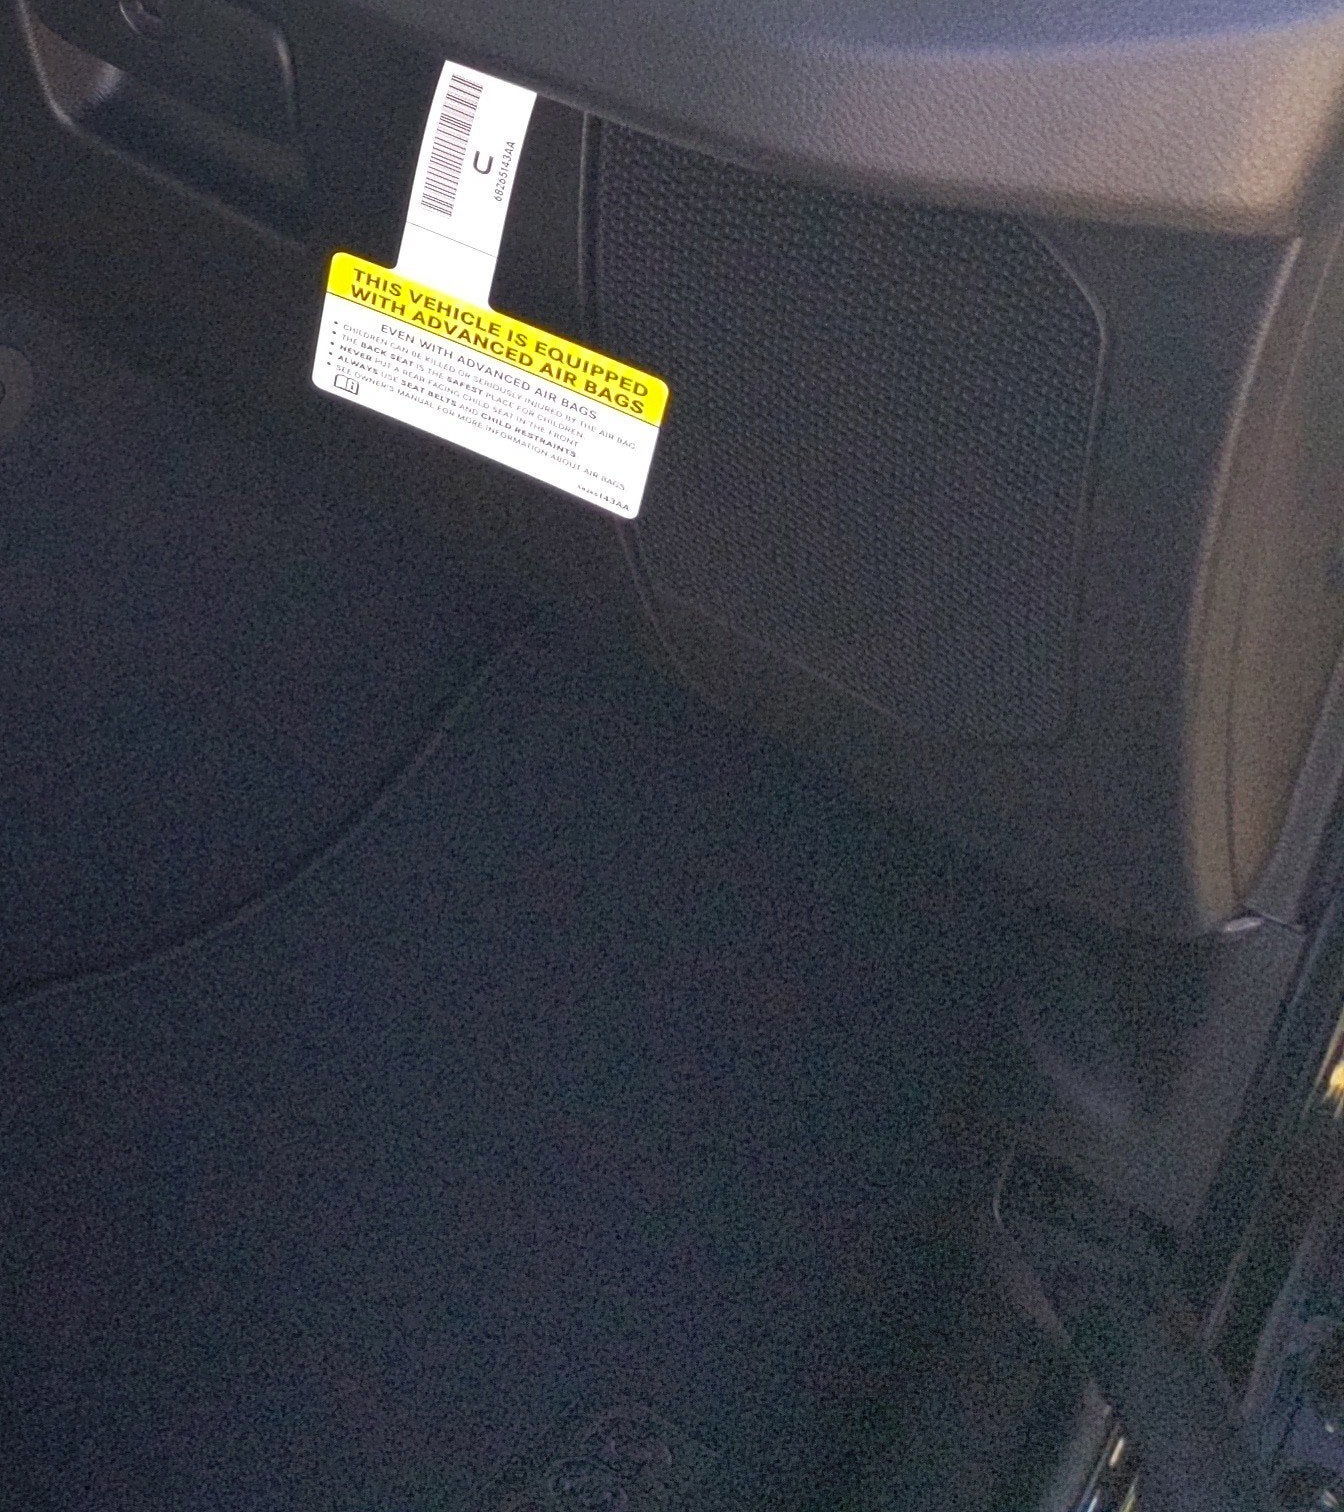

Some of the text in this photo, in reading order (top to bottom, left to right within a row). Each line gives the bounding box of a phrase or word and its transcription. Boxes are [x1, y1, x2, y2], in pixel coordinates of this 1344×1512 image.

[473, 150, 494, 175] U
[493, 141, 516, 202] 68265143AA
[342, 334, 358, 346] THE
[361, 341, 387, 356] BACK
[390, 353, 414, 367] SEAT
[427, 368, 444, 379] THE
[447, 376, 483, 395] SAFEST
[485, 392, 515, 408] PLACE
[516, 405, 535, 416] FOR
[351, 284, 645, 414] WITH ADVANCED AIR BAGS
[353, 267, 648, 397] THIS VEHICLE IS EQUIPPED
[381, 324, 597, 420] EVEN WITH ADVANCED AIR BAGS
[336, 364, 352, 376] SEE
[397, 389, 434, 408] MANUAL
[437, 405, 455, 417] FOR
[458, 414, 483, 430] MORE
[584, 468, 599, 478] AIR
[338, 355, 577, 458] ALWAYS USE SEAT BELTS AND CHILD RESTRAINTS
[339, 345, 372, 361] NEVER
[462, 393, 490, 409] CHILD
[492, 406, 513, 419] SEAT
[343, 324, 388, 346] CHILDREN
[390, 342, 408, 354] CAN
[412, 350, 422, 360] BE
[425, 356, 456, 373] KILLED
[458, 369, 471, 378] OR
[473, 375, 523, 400] SERIOUSLY
[524, 397, 563, 418] INJURED
[565, 414, 576, 423] BY
[580, 420, 596, 432] THE
[599, 429, 615, 440] AIR
